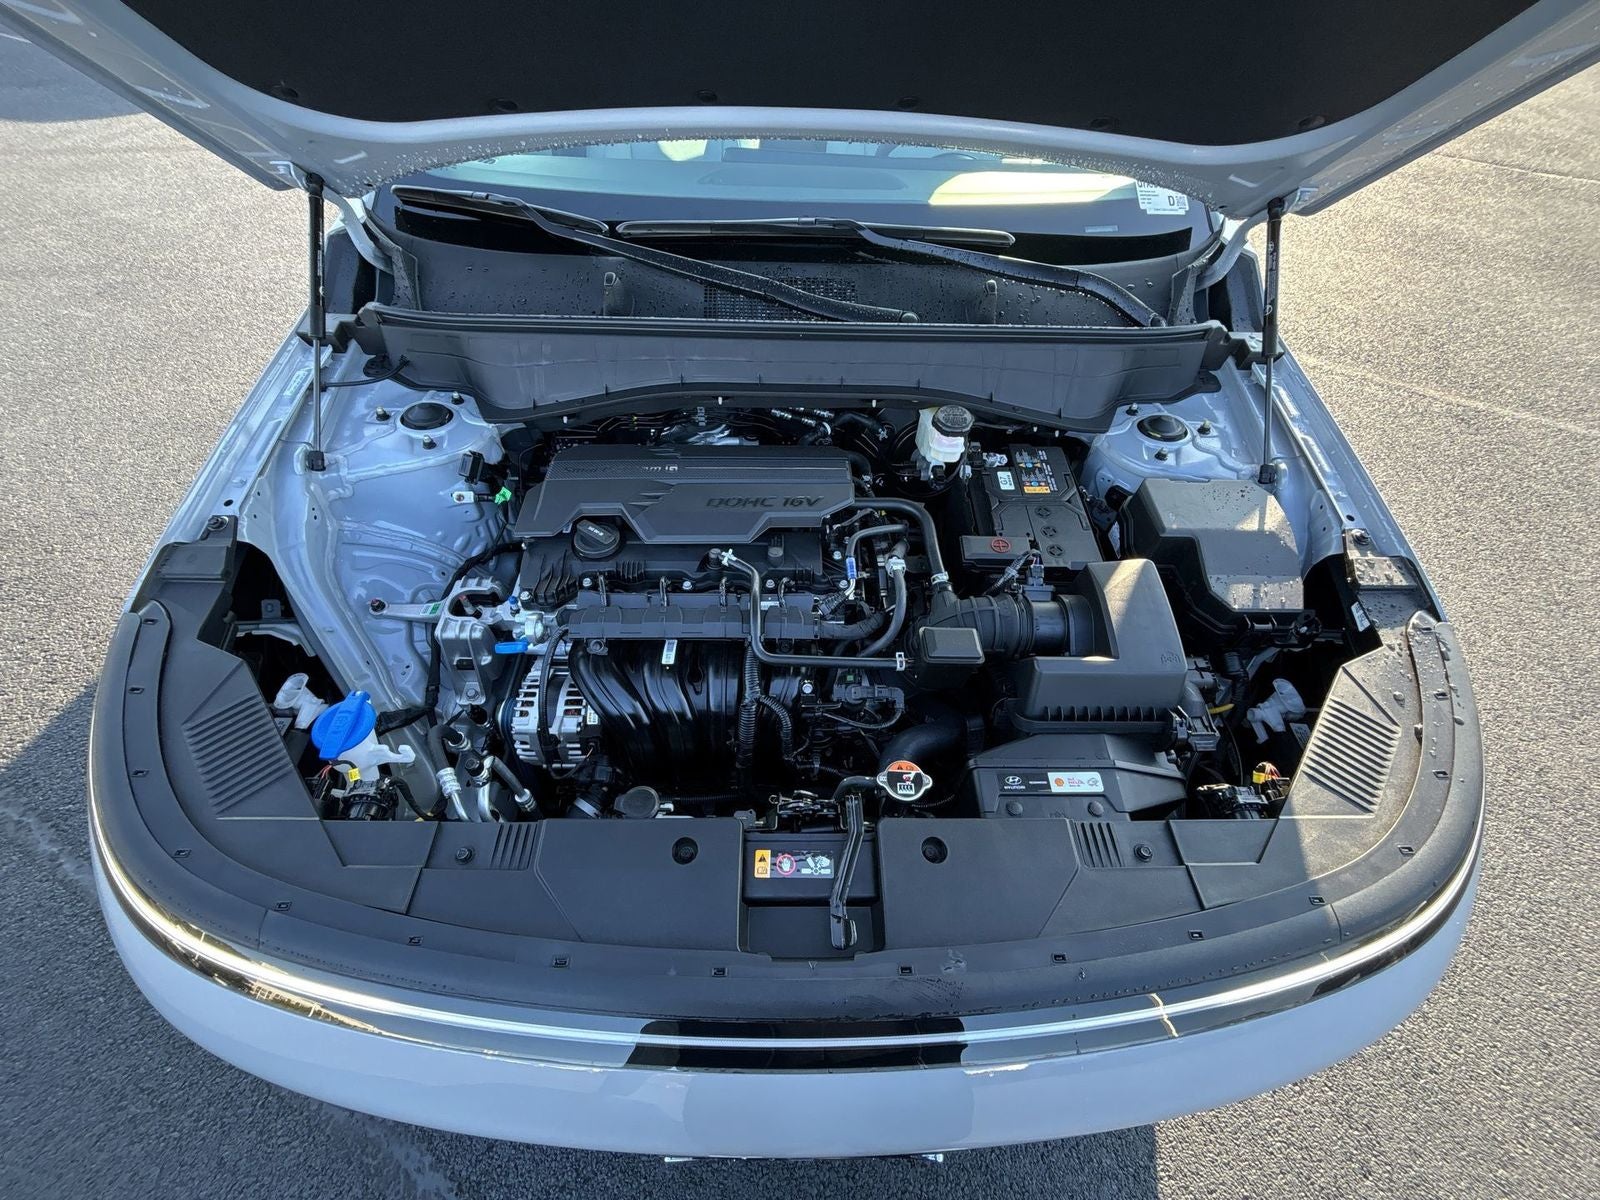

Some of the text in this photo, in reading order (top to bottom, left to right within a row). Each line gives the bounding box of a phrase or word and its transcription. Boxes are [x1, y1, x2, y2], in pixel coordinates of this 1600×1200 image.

[1168, 195, 1175, 206] D
[706, 495, 824, 508] DOHC 16V
